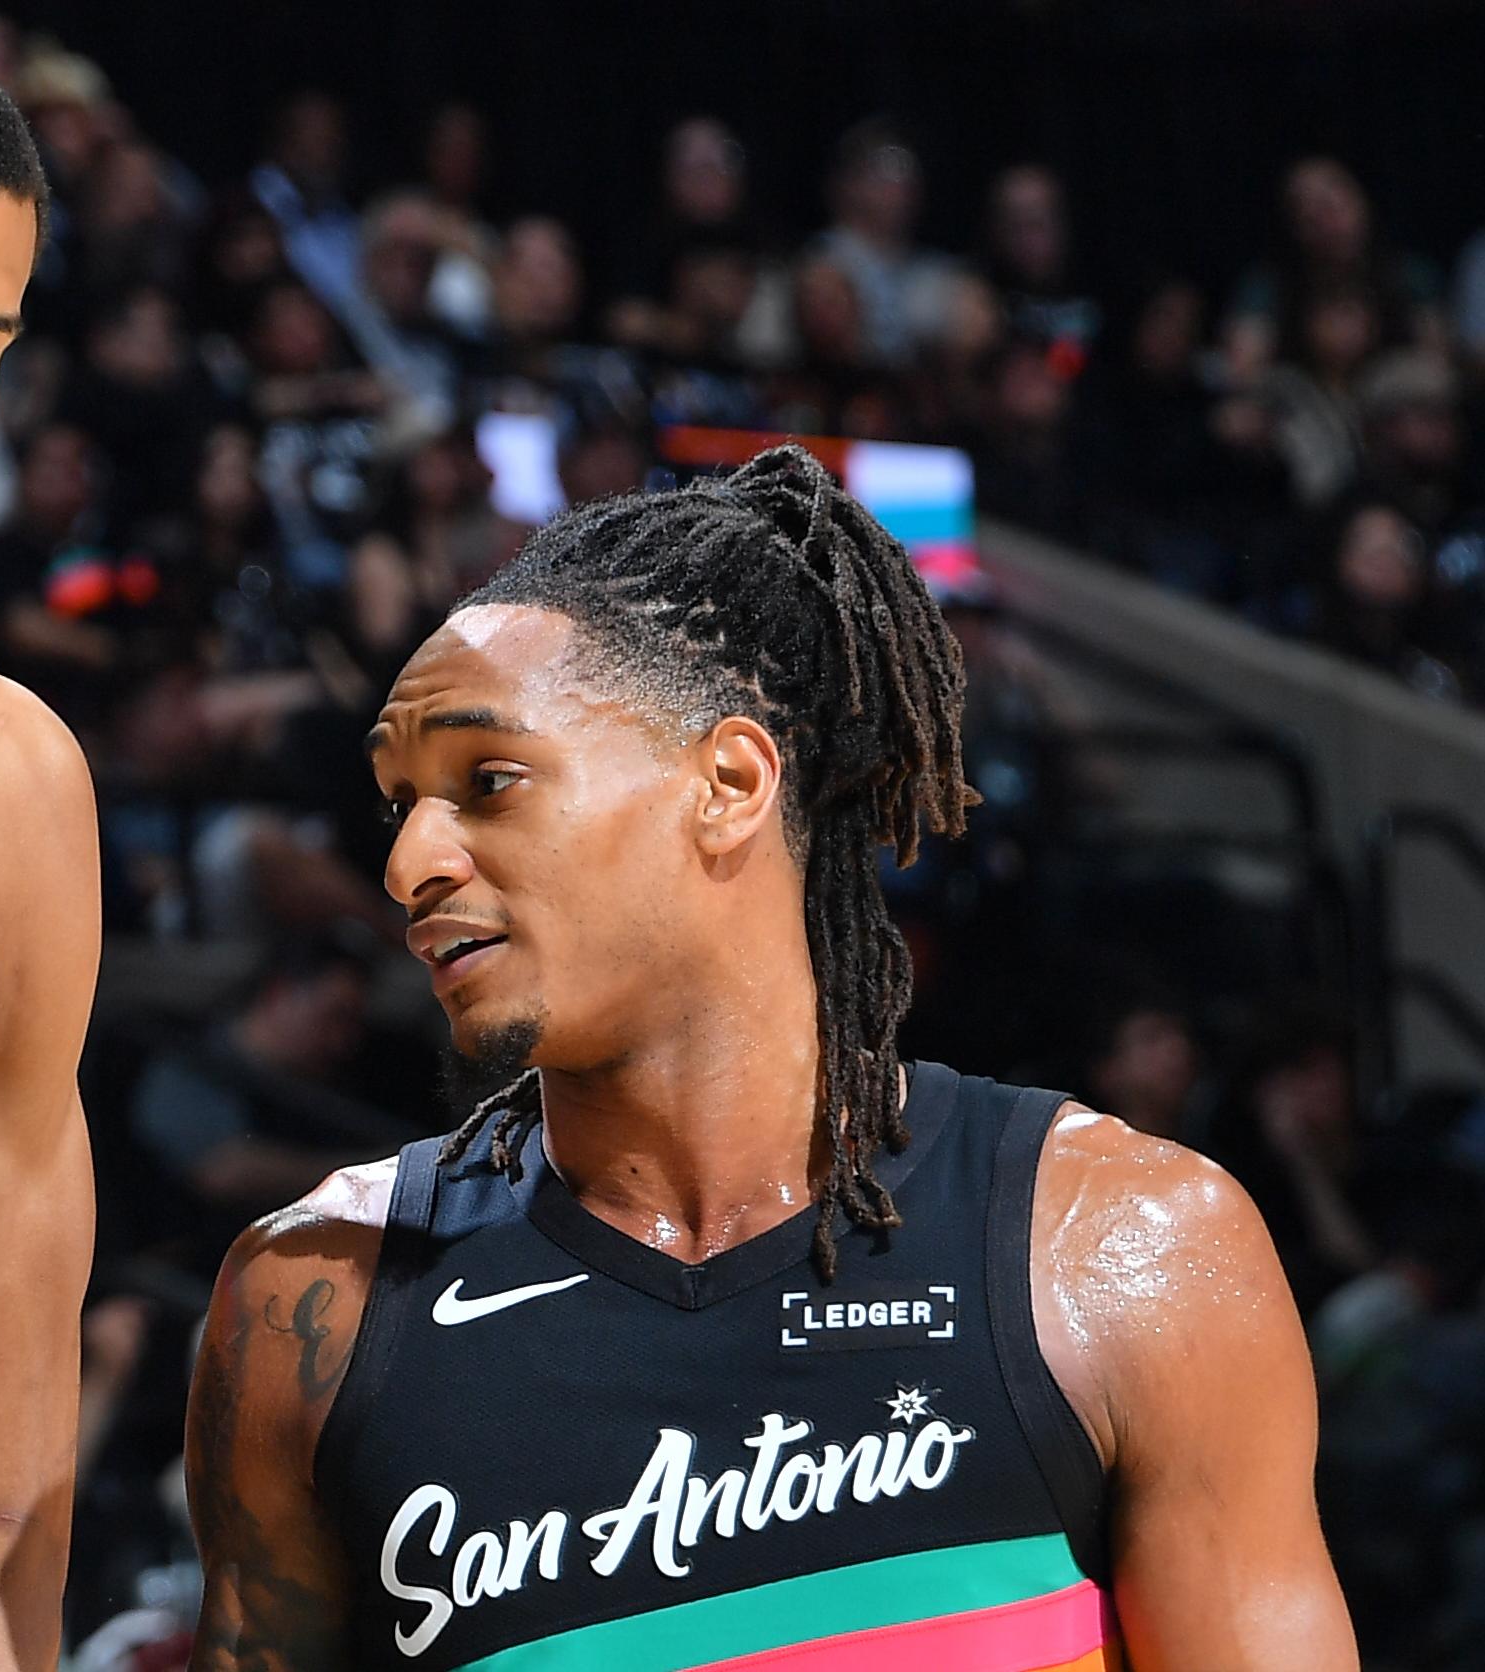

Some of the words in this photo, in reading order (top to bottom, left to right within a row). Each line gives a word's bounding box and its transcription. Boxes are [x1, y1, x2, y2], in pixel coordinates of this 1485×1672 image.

[803, 1300, 933, 1331] LEDGER
[379, 1483, 569, 1658] San
[580, 1388, 973, 1578] Antonio
